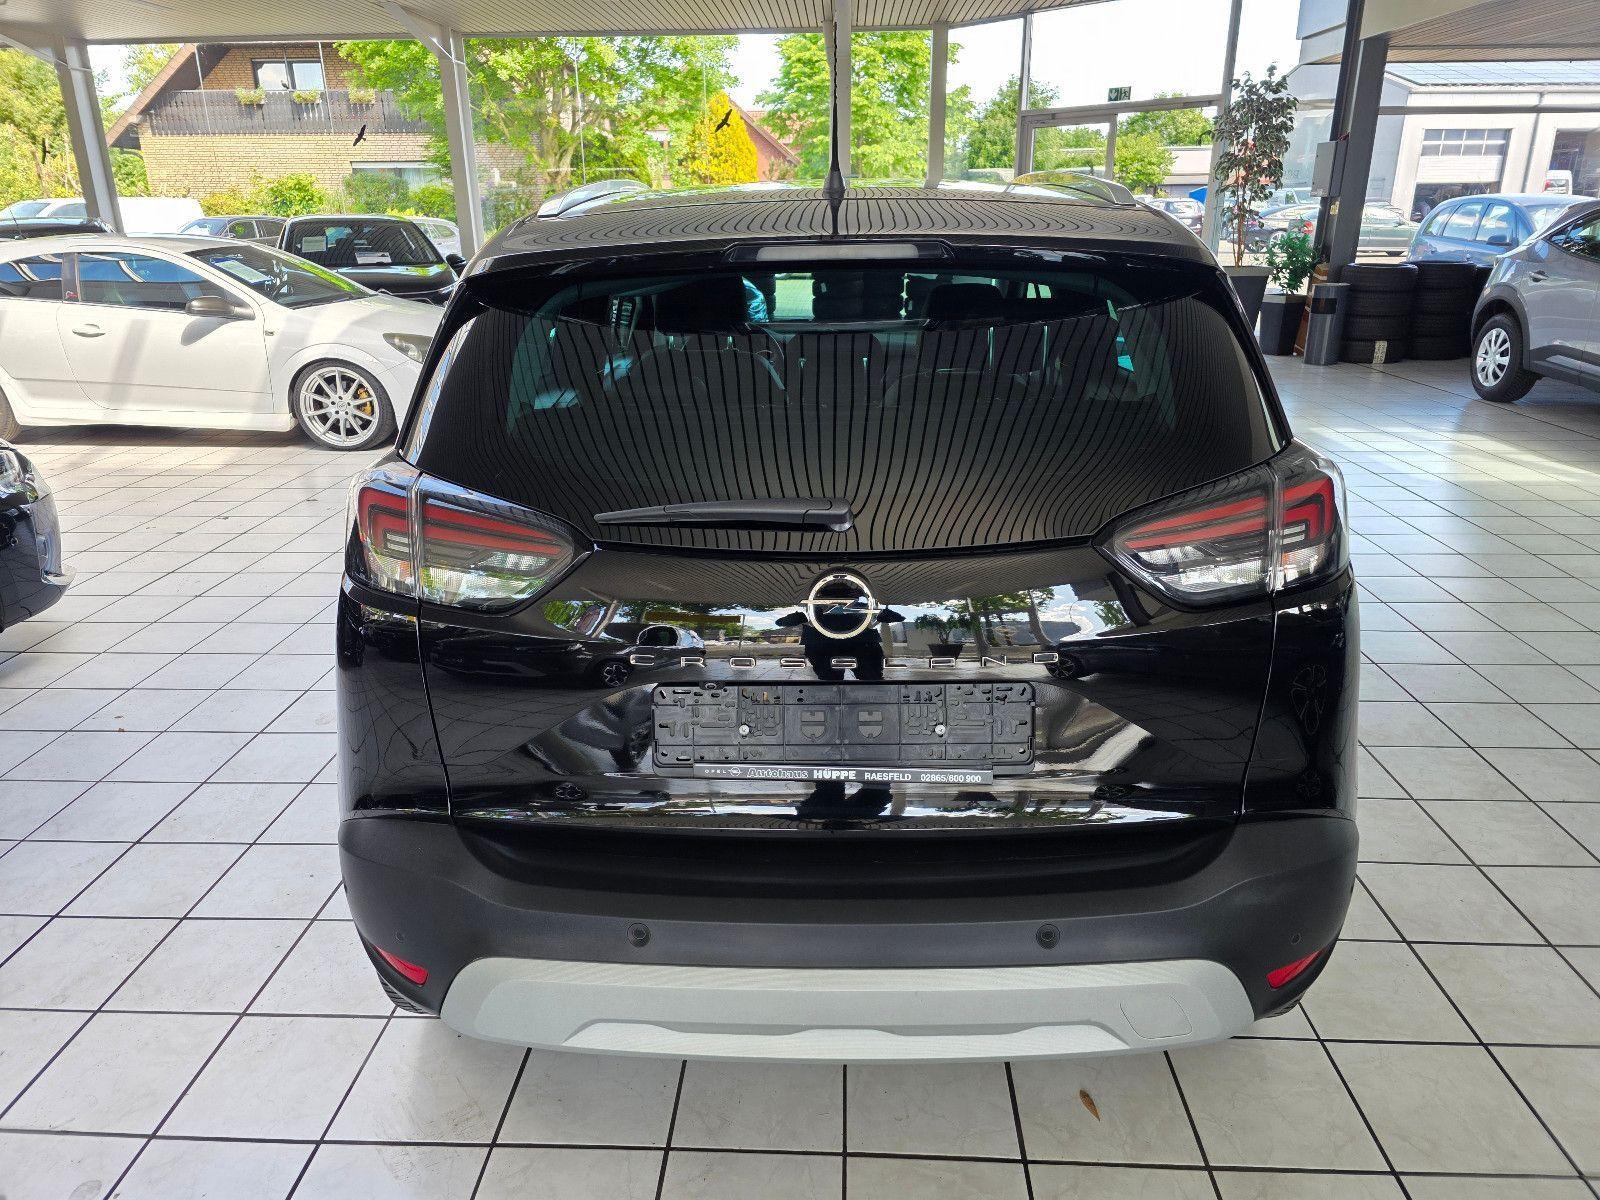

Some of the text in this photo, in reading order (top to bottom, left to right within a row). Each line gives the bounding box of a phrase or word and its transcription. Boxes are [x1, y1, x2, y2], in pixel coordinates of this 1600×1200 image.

[629, 652, 1061, 669] CROSSLAND
[746, 768, 808, 778] Autohaus
[813, 769, 856, 780] HÜPPE
[864, 772, 912, 781] RAESFELD
[965, 774, 982, 783] 900
